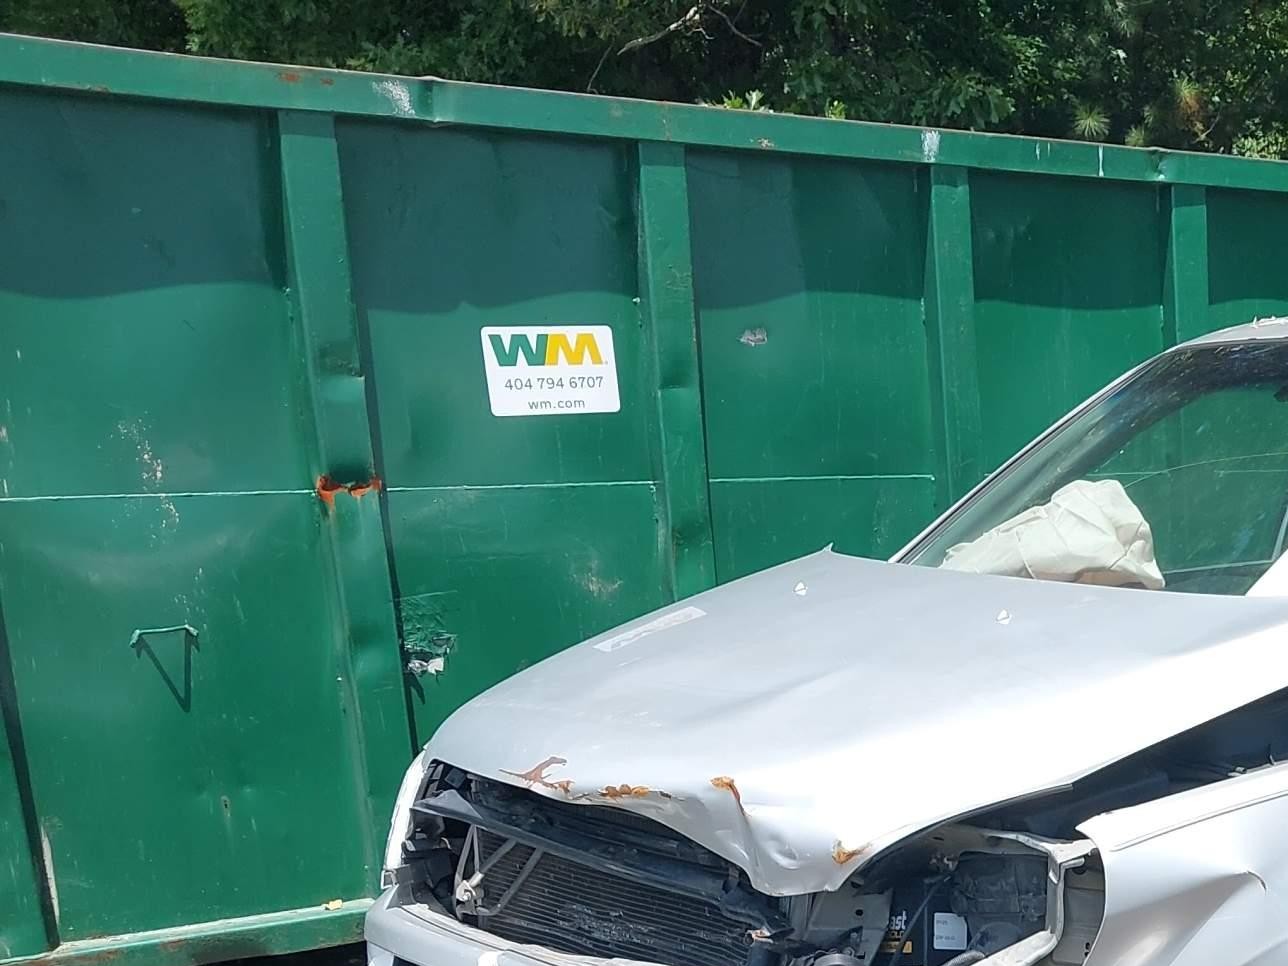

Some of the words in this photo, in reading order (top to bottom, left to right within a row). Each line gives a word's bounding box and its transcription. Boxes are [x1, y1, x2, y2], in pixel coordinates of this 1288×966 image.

[488, 333, 604, 367] WM
[504, 378, 533, 390] 404
[537, 377, 565, 390] 794
[569, 376, 604, 389] 6707
[528, 399, 586, 410] wm.com
